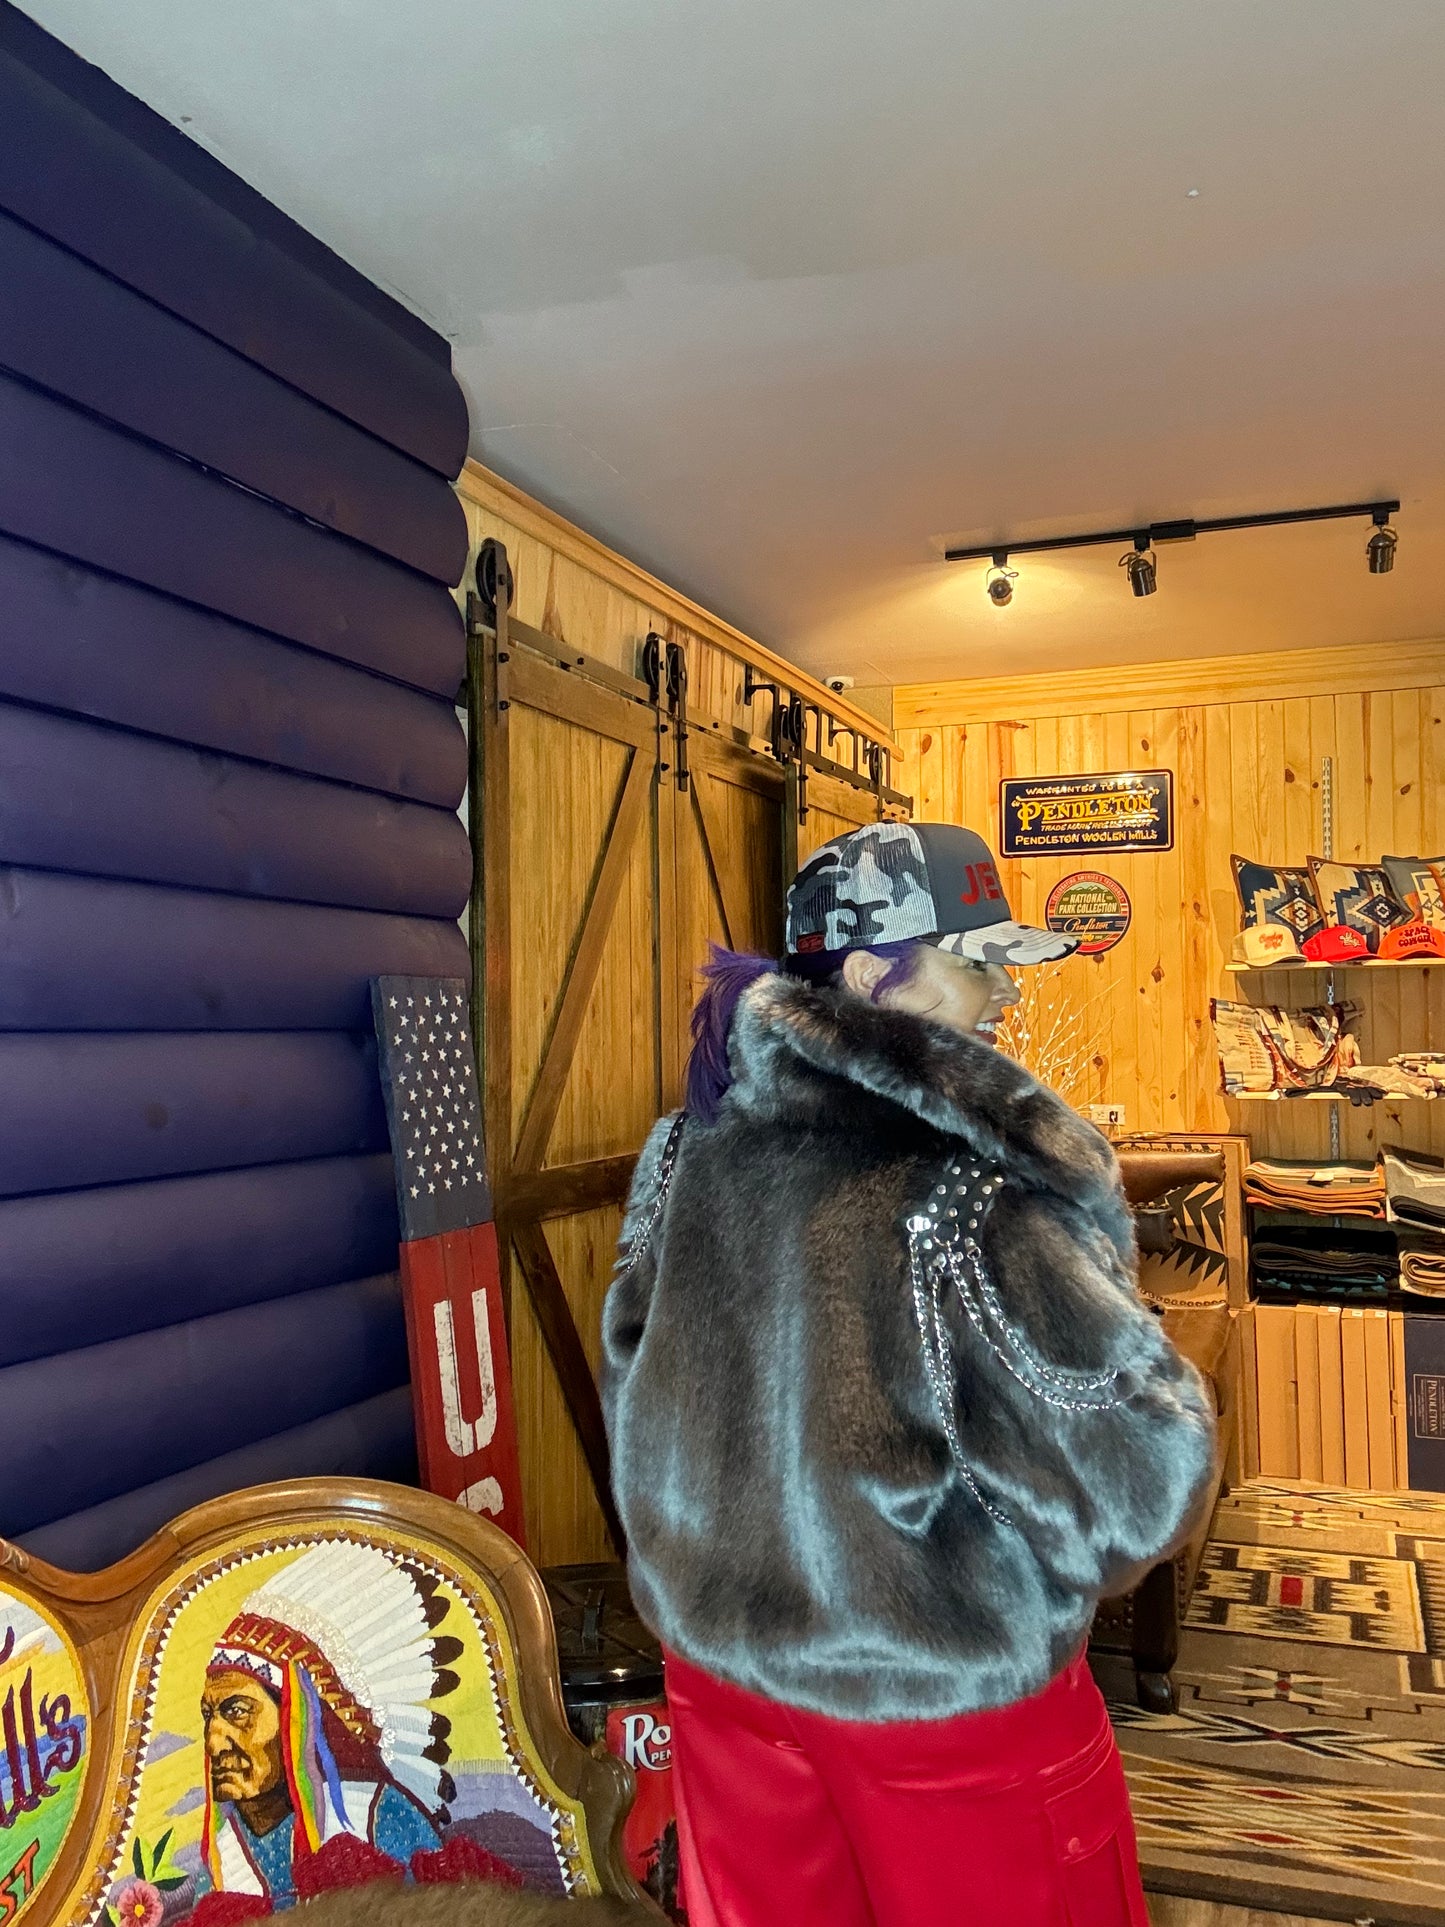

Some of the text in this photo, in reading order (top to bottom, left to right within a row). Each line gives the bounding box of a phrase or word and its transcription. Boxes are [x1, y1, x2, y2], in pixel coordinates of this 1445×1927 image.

[1025, 783, 1097, 795] WARRANTED
[1100, 783, 1113, 791] TO
[1041, 824, 1066, 832] TRADE
[1067, 822, 1091, 830] MARK
[1015, 829, 1158, 846] PENDLETON WOOLEN MILLS
[1070, 893, 1106, 904] NATIONAL
[1058, 902, 1118, 914] PARK COLLECTION
[1063, 917, 1114, 933] Pendleton
[1426, 1380, 1438, 1432] PENDLETON
